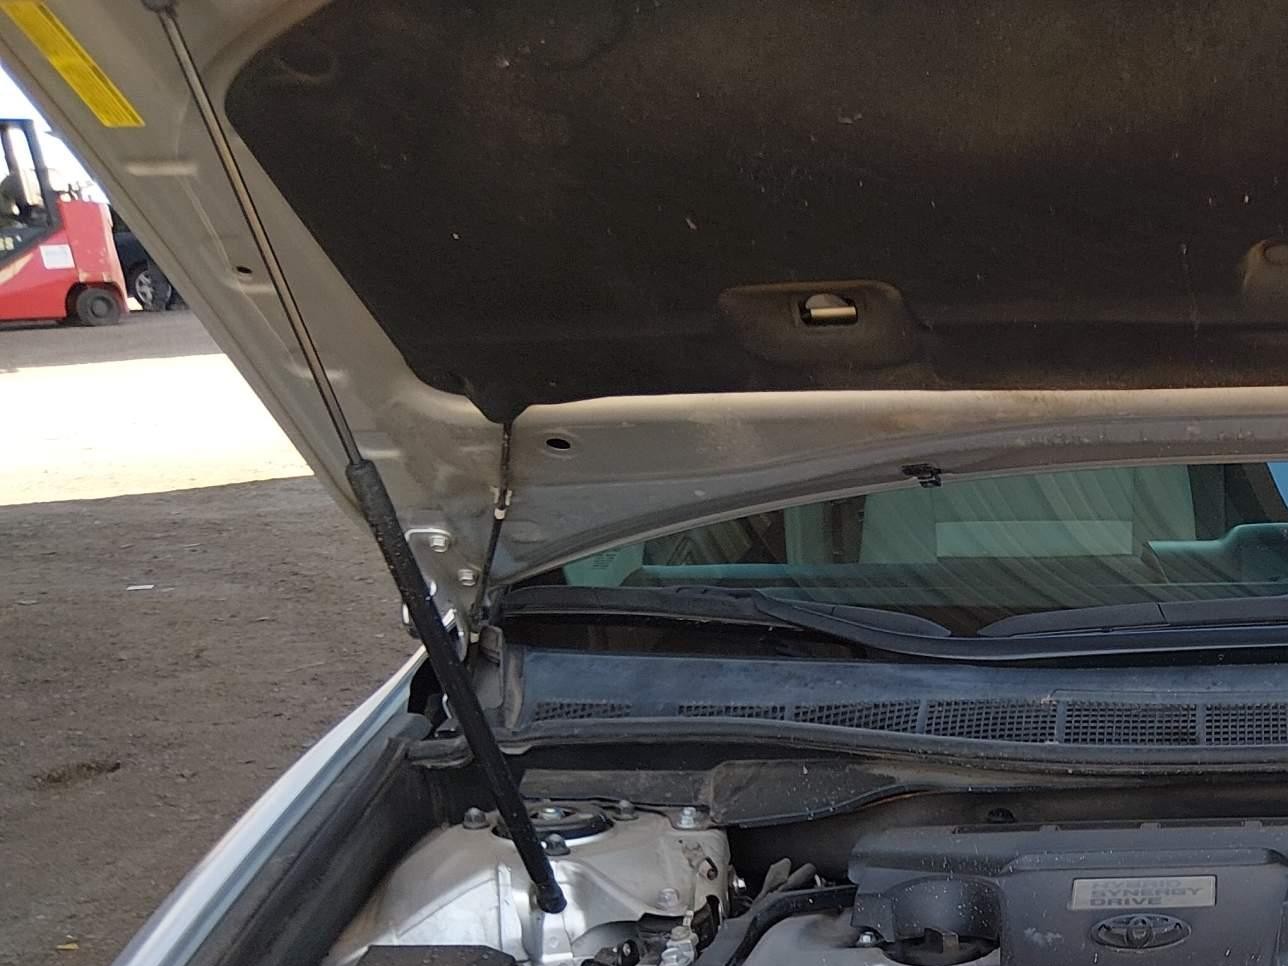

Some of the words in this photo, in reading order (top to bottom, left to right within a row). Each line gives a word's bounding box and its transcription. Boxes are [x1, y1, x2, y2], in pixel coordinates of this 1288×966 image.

[1091, 879, 1183, 889] HYBRID
[1091, 887, 1204, 897] SYNERGY
[1090, 896, 1163, 907] DRIVE
